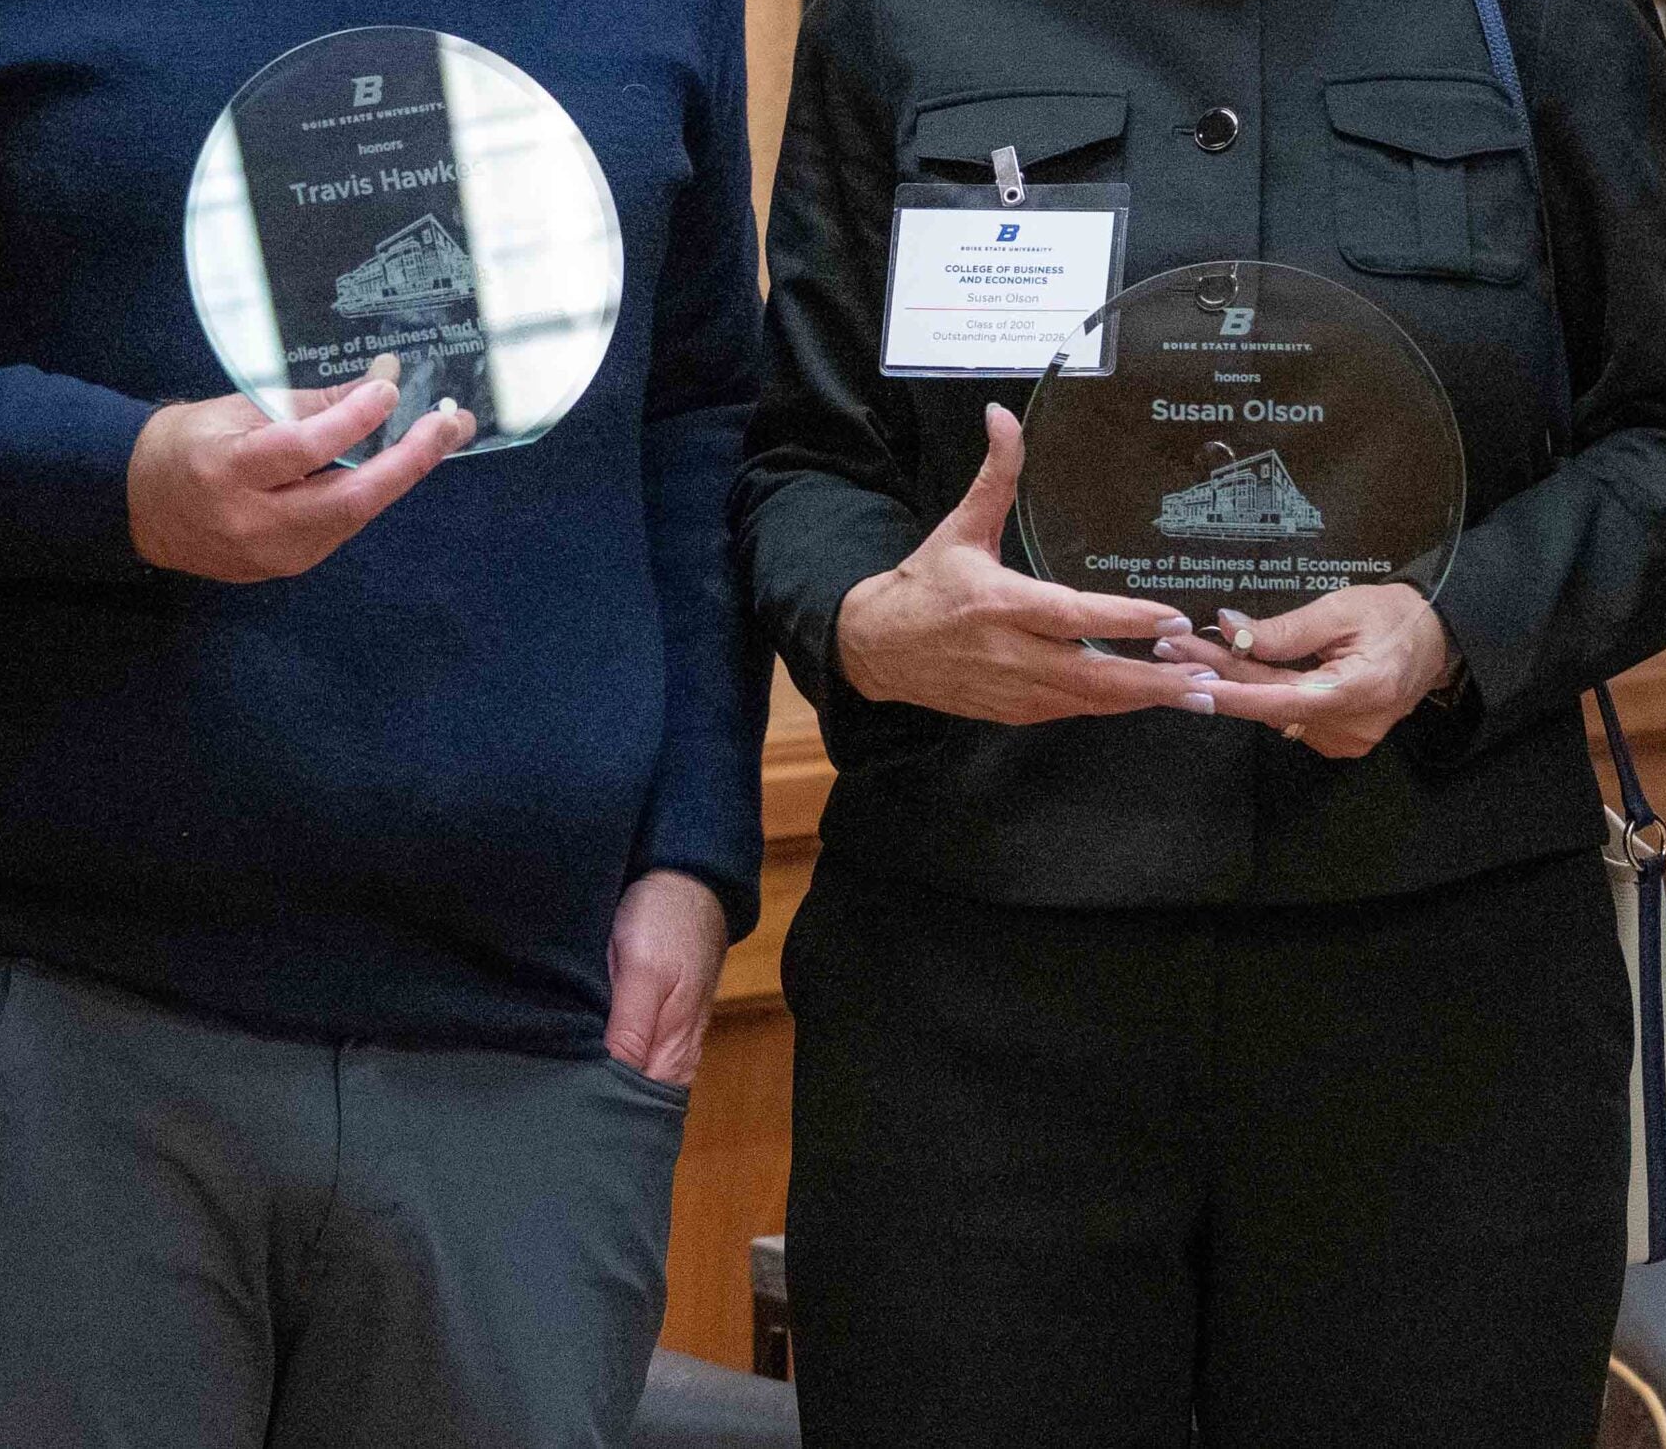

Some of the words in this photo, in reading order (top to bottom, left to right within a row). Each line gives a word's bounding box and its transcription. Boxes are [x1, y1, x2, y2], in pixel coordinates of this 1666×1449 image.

[351, 75, 383, 107] B
[301, 118, 336, 131] BOISE
[339, 112, 374, 125] STATE
[358, 139, 404, 155] honors
[289, 173, 374, 206] Travis
[996, 224, 1020, 242] B
[945, 264, 993, 273] COLLEGE
[996, 265, 1010, 273] OF
[1014, 266, 1064, 274] BUSINESS
[959, 276, 982, 284] AND
[985, 276, 1048, 285] ECONOMICS
[966, 292, 1001, 303] Susan
[1005, 293, 1039, 304] Olson
[966, 319, 993, 329] Class
[996, 319, 1007, 329] of
[1010, 320, 1035, 330] 2001
[1219, 307, 1255, 335] B
[343, 336, 362, 353] of
[365, 326, 439, 351] Business
[440, 318, 474, 339] and
[933, 331, 997, 343] Outstanding
[1000, 332, 1036, 342] Alumni
[1039, 333, 1066, 342] 2026
[428, 336, 485, 358] Alumni
[1162, 342, 1198, 351] BOISE
[1202, 342, 1237, 351] STATE
[1214, 371, 1262, 383] honors
[1150, 399, 1234, 422] Susan
[1242, 399, 1324, 423] Olson
[1085, 554, 1151, 572] College
[1156, 554, 1175, 570] of
[1179, 555, 1255, 571] Business
[1259, 556, 1293, 572] and
[1297, 557, 1392, 573] Economics
[1126, 574, 1234, 592] Outstanding
[1239, 575, 1301, 590] Alumni
[1305, 576, 1350, 591] 2026
